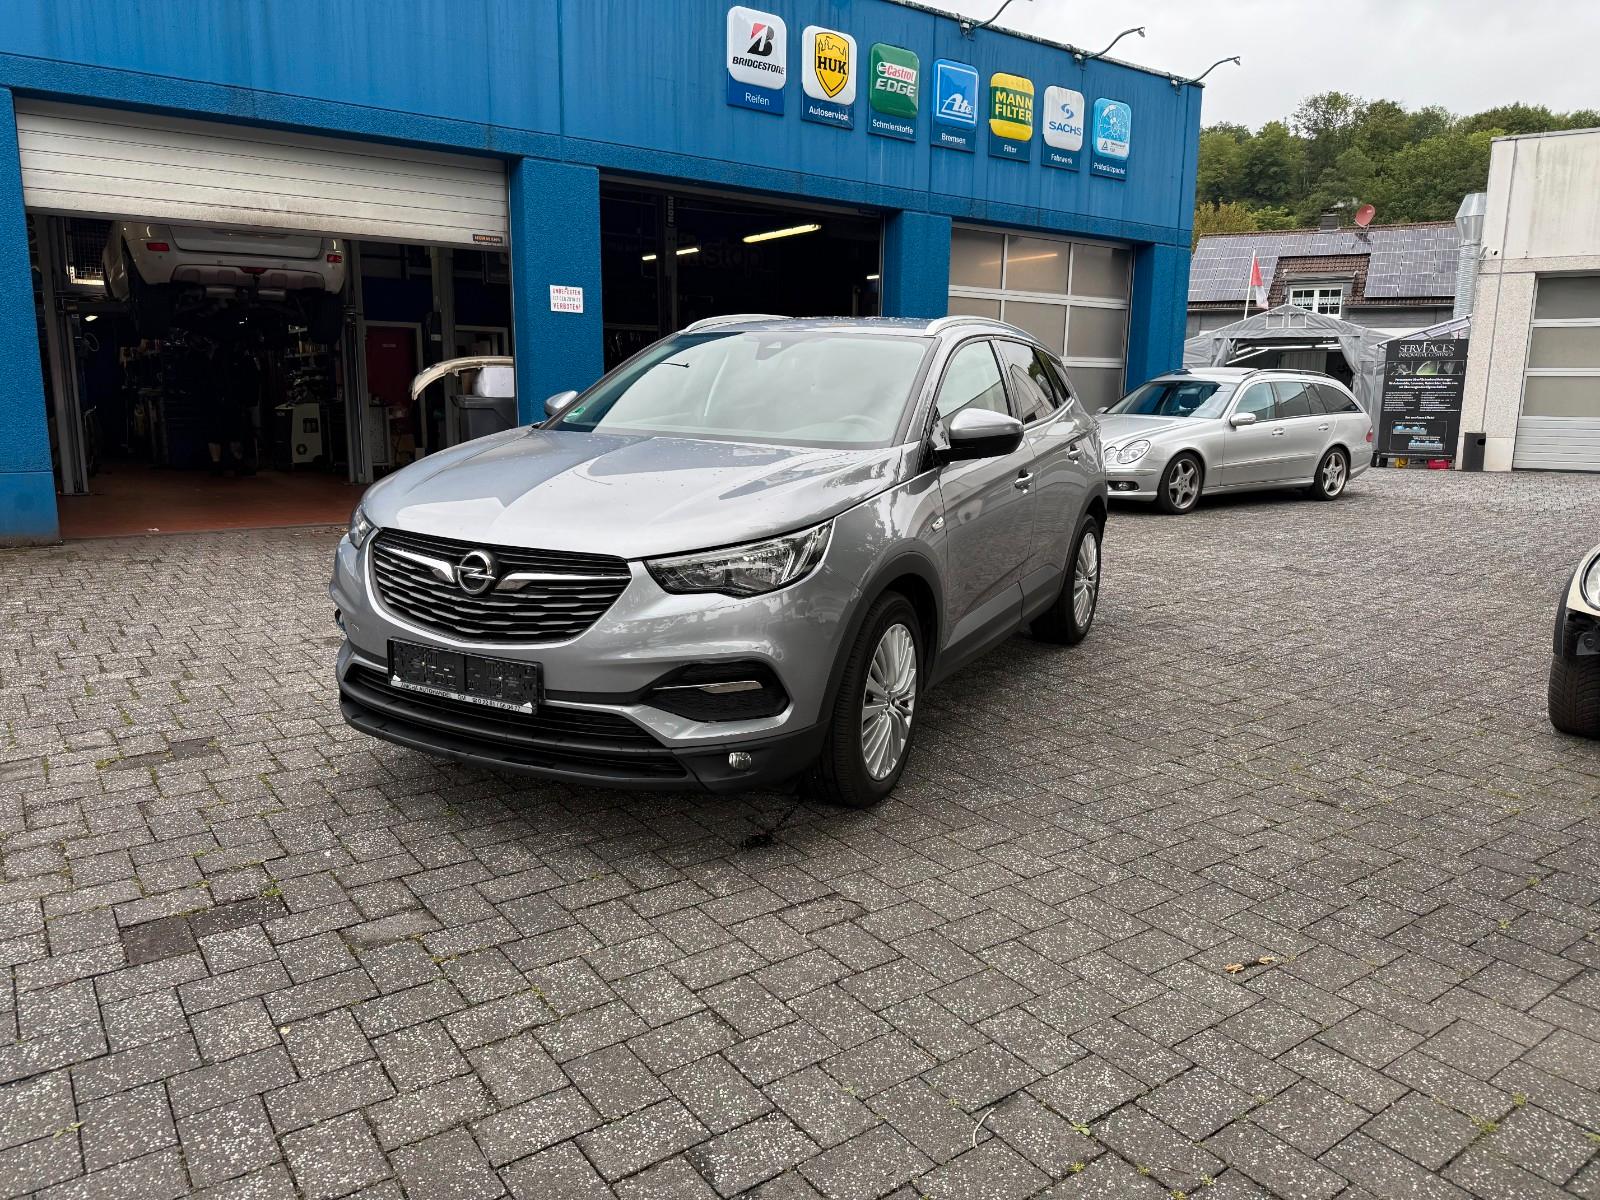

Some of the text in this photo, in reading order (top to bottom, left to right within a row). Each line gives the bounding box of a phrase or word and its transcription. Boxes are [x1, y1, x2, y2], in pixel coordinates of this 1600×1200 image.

[732, 56, 784, 75] BRIDGESTONE
[816, 56, 846, 75] HUK
[887, 65, 914, 82] Castrol
[875, 78, 916, 97] EDGE
[745, 92, 770, 106] Reifen
[942, 93, 974, 114] Ate
[995, 91, 1032, 110] MANN
[808, 105, 849, 121] Autoservice
[995, 103, 1032, 122] FILTER
[872, 119, 914, 135] Schmierstoffe
[1049, 121, 1082, 136] SACHS
[941, 132, 966, 145] Bremsen
[1003, 144, 1017, 153] Filter
